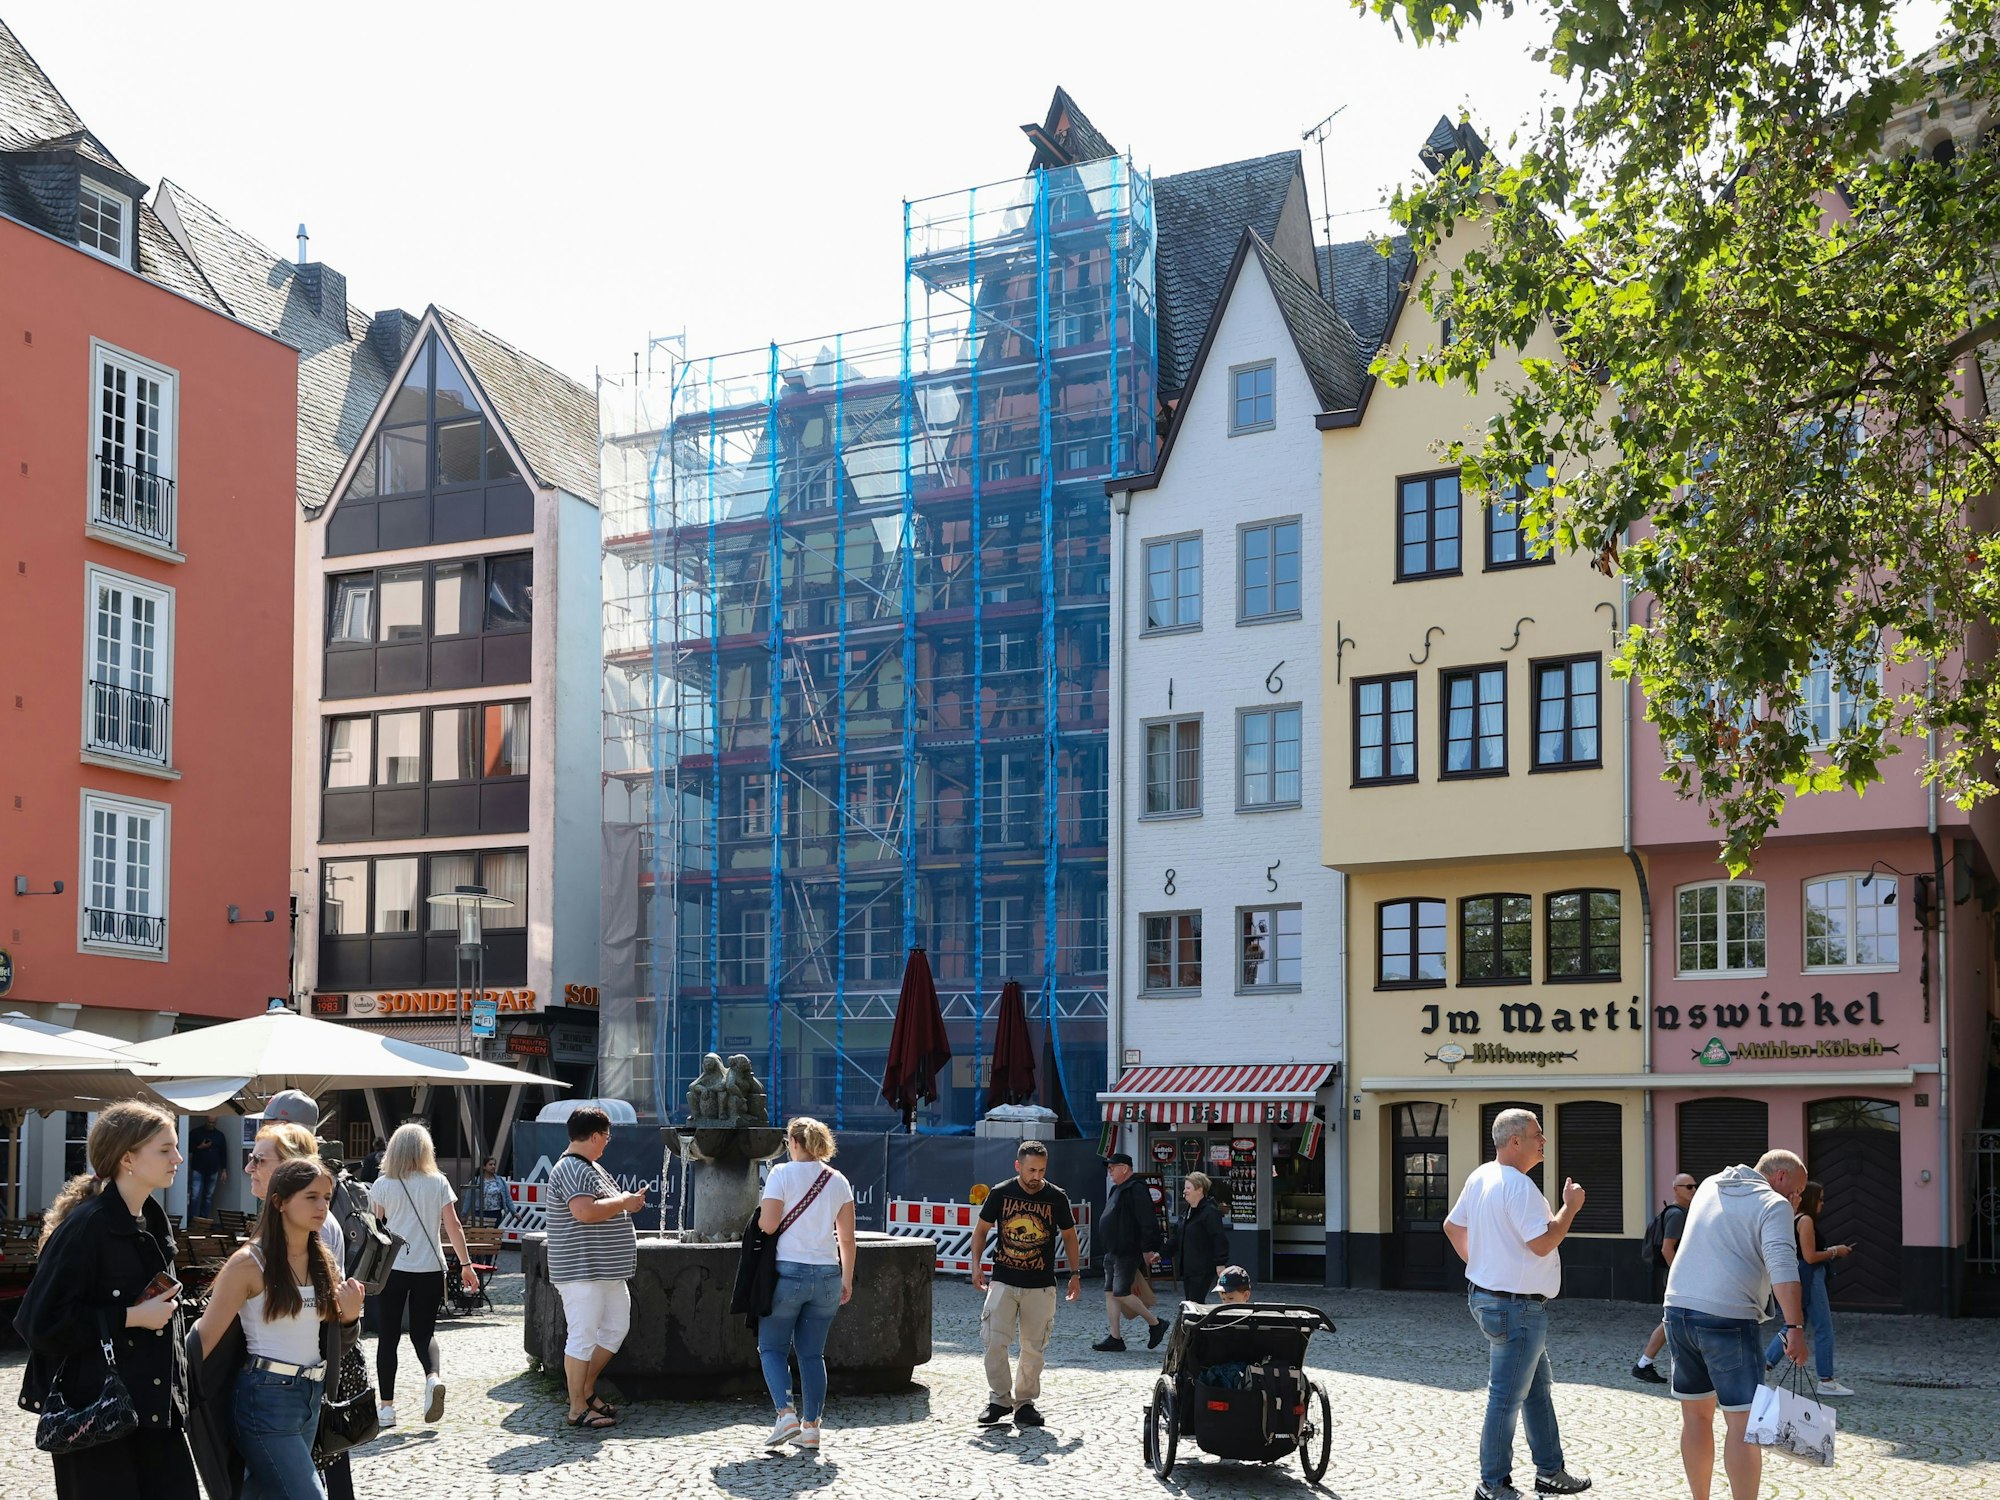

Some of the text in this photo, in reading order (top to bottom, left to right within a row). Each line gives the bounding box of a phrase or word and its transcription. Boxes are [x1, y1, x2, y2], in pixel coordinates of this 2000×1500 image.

[316, 1003, 338, 1012] 1983
[377, 990, 537, 1014] SONDERBAR
[1421, 991, 1885, 1035] Im Martinswinkel
[510, 1044, 547, 1054] TRINKEN
[1472, 1042, 1564, 1067] Bitburger
[1736, 1040, 1811, 1060] Mühlen
[1816, 1037, 1883, 1057] Kölsch
[1124, 1104, 1149, 1120] Eis
[1191, 1105, 1220, 1121] Eis
[1266, 1105, 1292, 1121] Eis
[1002, 1198, 1053, 1225] HAKUNA
